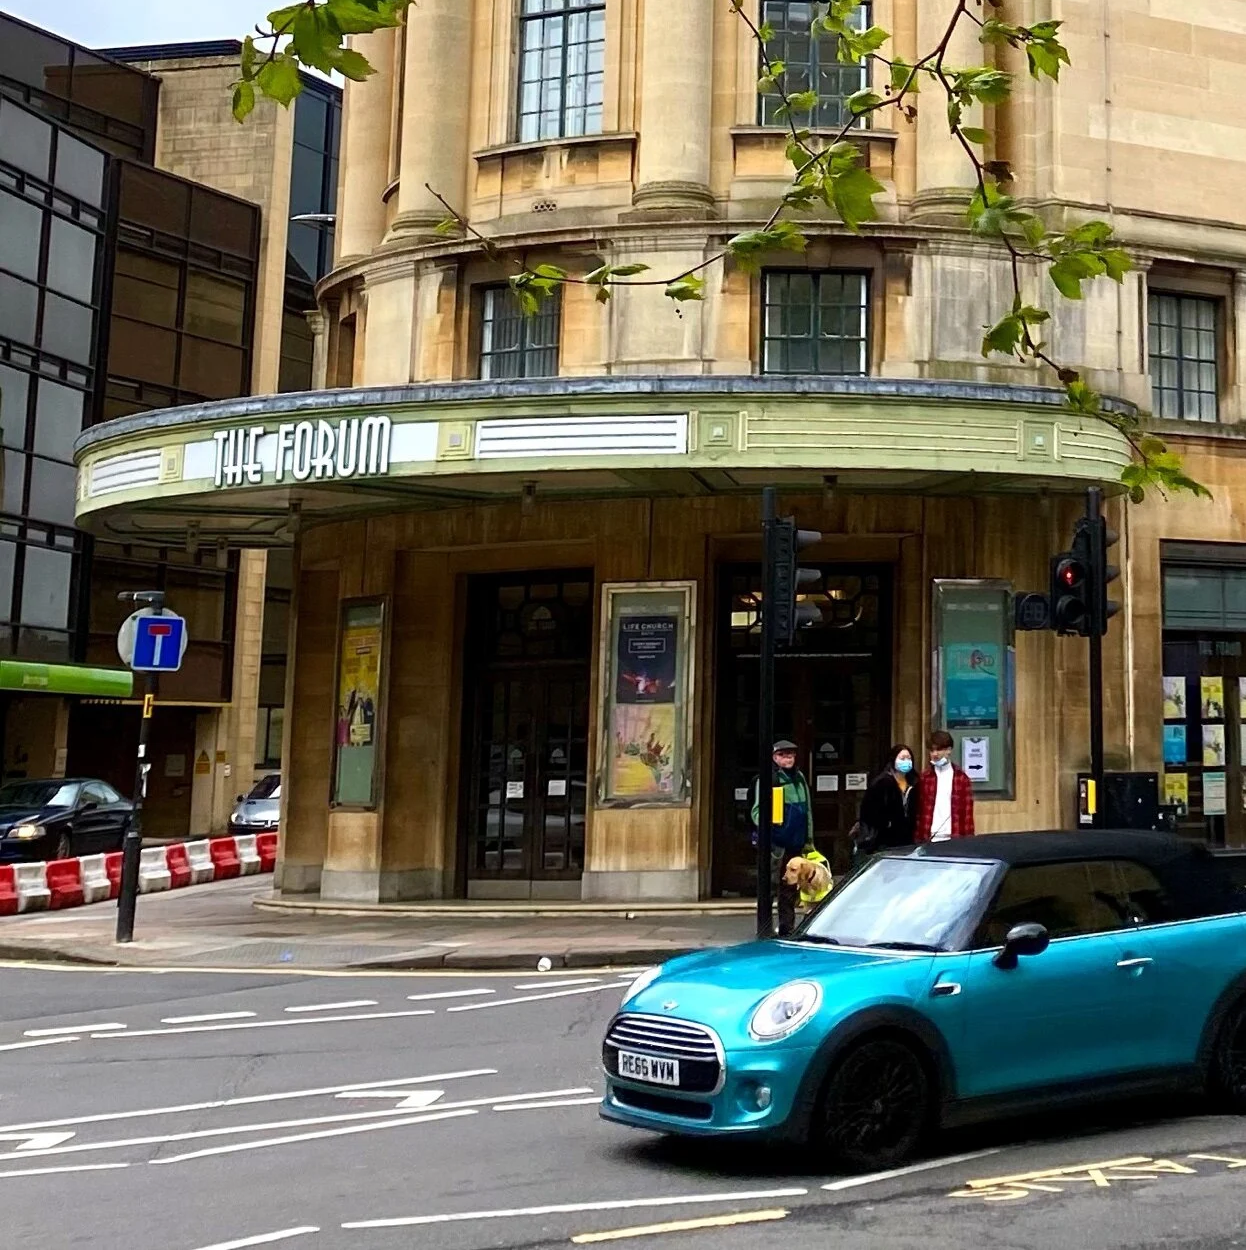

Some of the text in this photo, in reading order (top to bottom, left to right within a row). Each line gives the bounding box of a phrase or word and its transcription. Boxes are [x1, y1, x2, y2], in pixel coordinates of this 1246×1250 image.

[213, 415, 392, 487] THE FORUM
[622, 1053, 674, 1082] RE66 WVM
